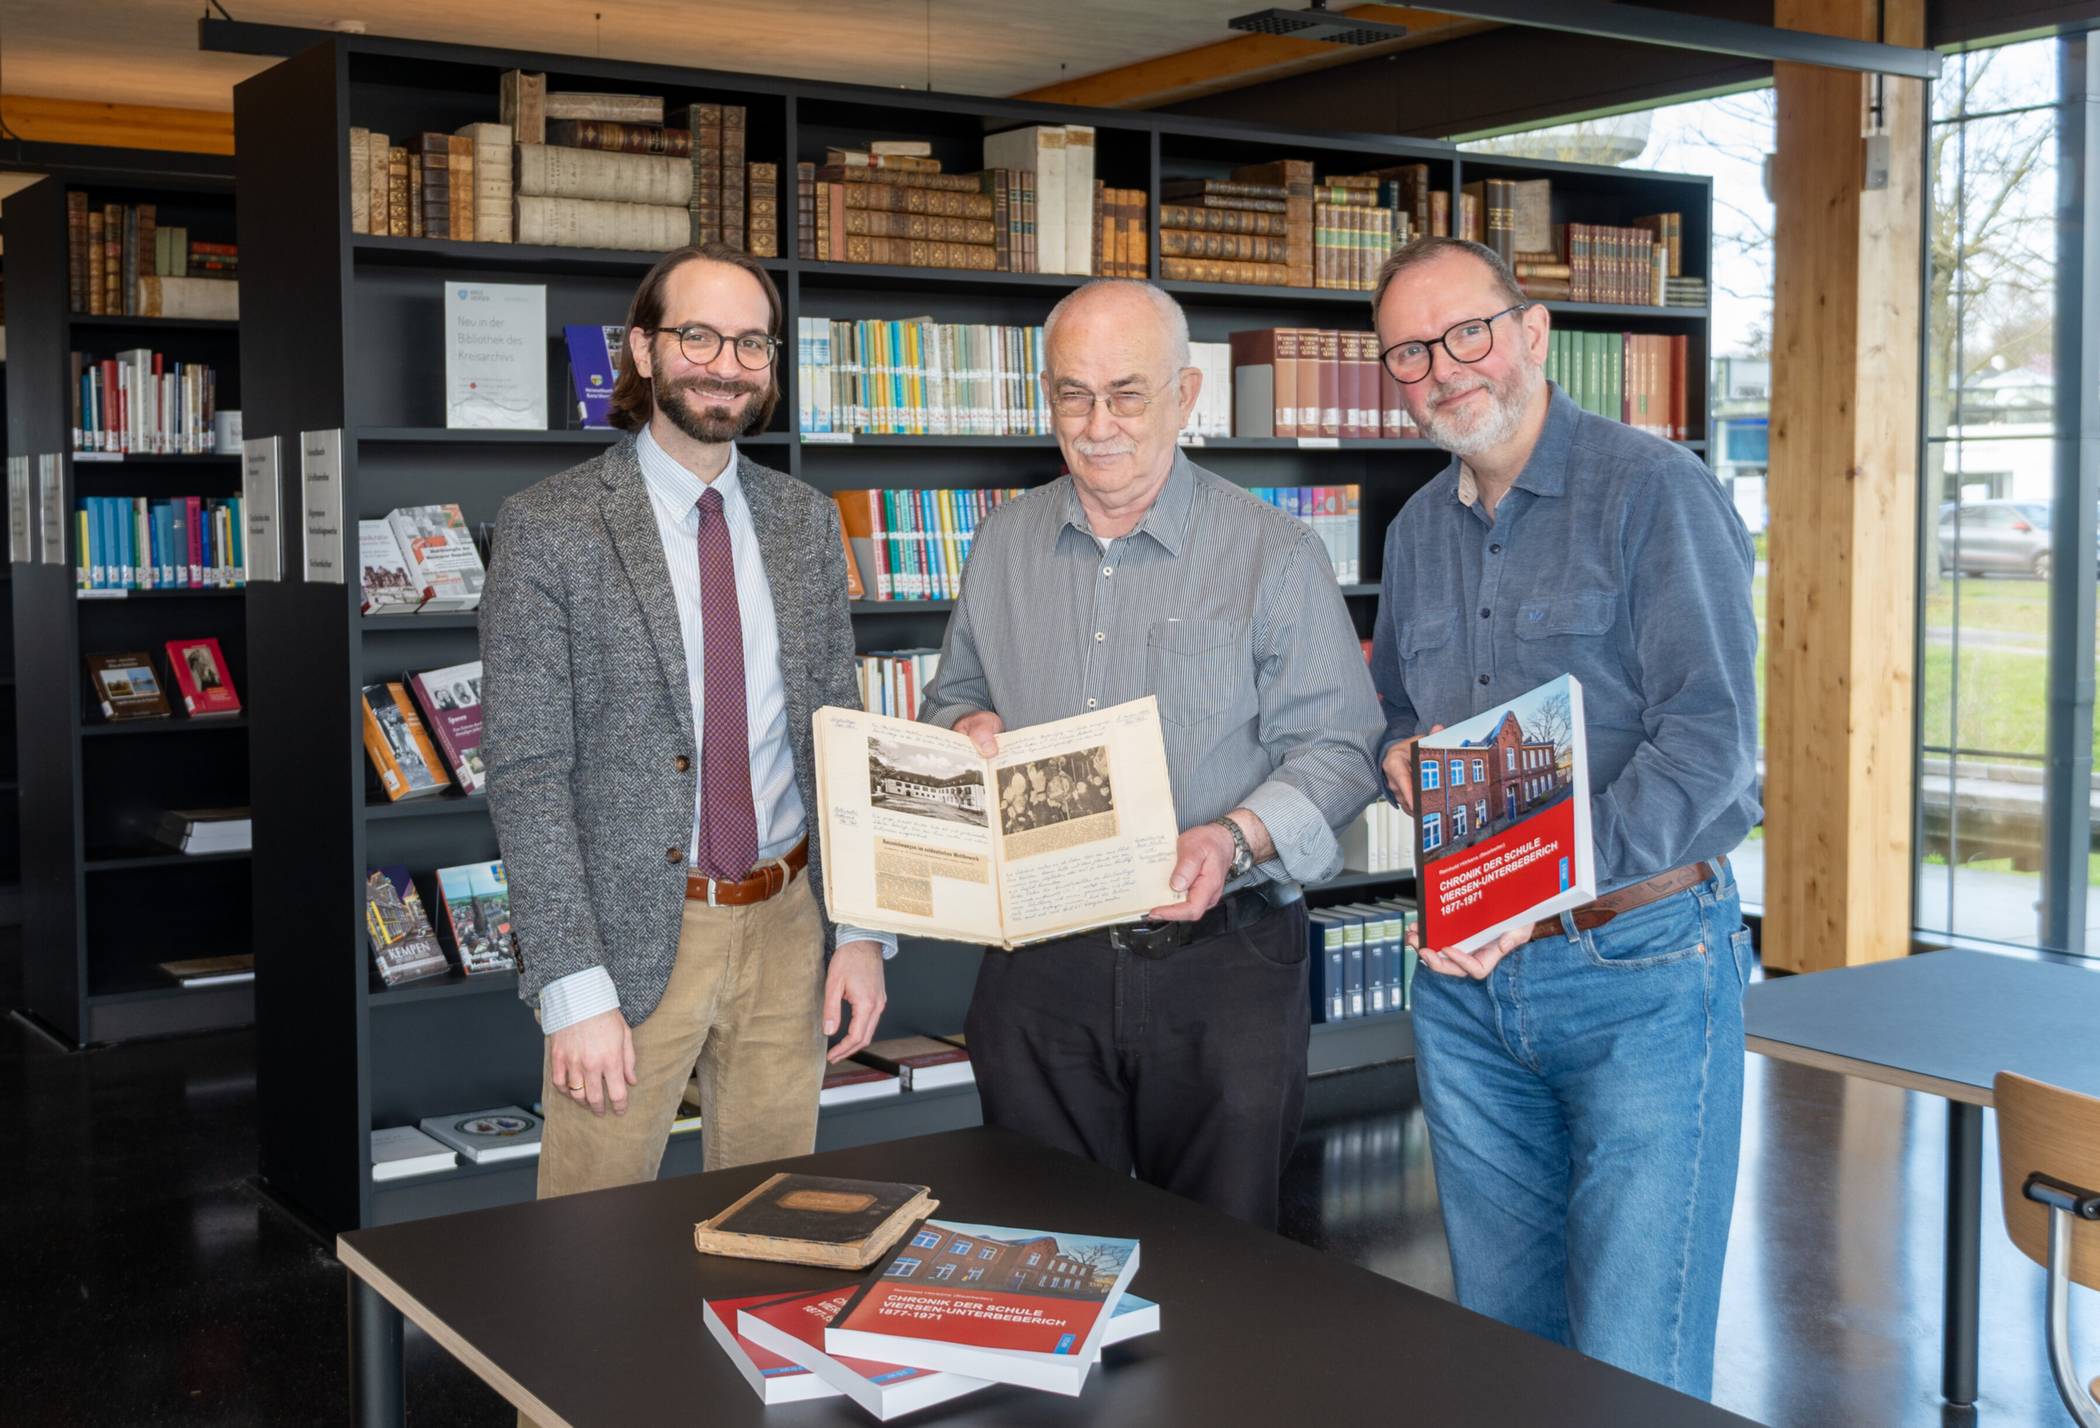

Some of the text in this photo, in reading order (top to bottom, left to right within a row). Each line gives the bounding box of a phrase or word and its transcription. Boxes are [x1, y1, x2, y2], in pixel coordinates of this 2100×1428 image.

[458, 315, 504, 328] Neu in der
[457, 332, 522, 346] Bibliothek des
[458, 350, 515, 362] Kreisarchivs
[1439, 837, 1541, 892] CHRONIK DER SCHULE
[1440, 841, 1558, 903] VIERSEN-UNTERBEBERICH
[1440, 890, 1483, 917] 1877-1971
[388, 941, 431, 959] KEMPEN
[878, 1307, 943, 1321] 1877-1971
[882, 1301, 1067, 1327] VIERSEN-UNTERBEBERICH
[887, 1294, 950, 1307] CHRONIK
[953, 1300, 984, 1311] DER
[987, 1304, 1044, 1317] SCHULE
